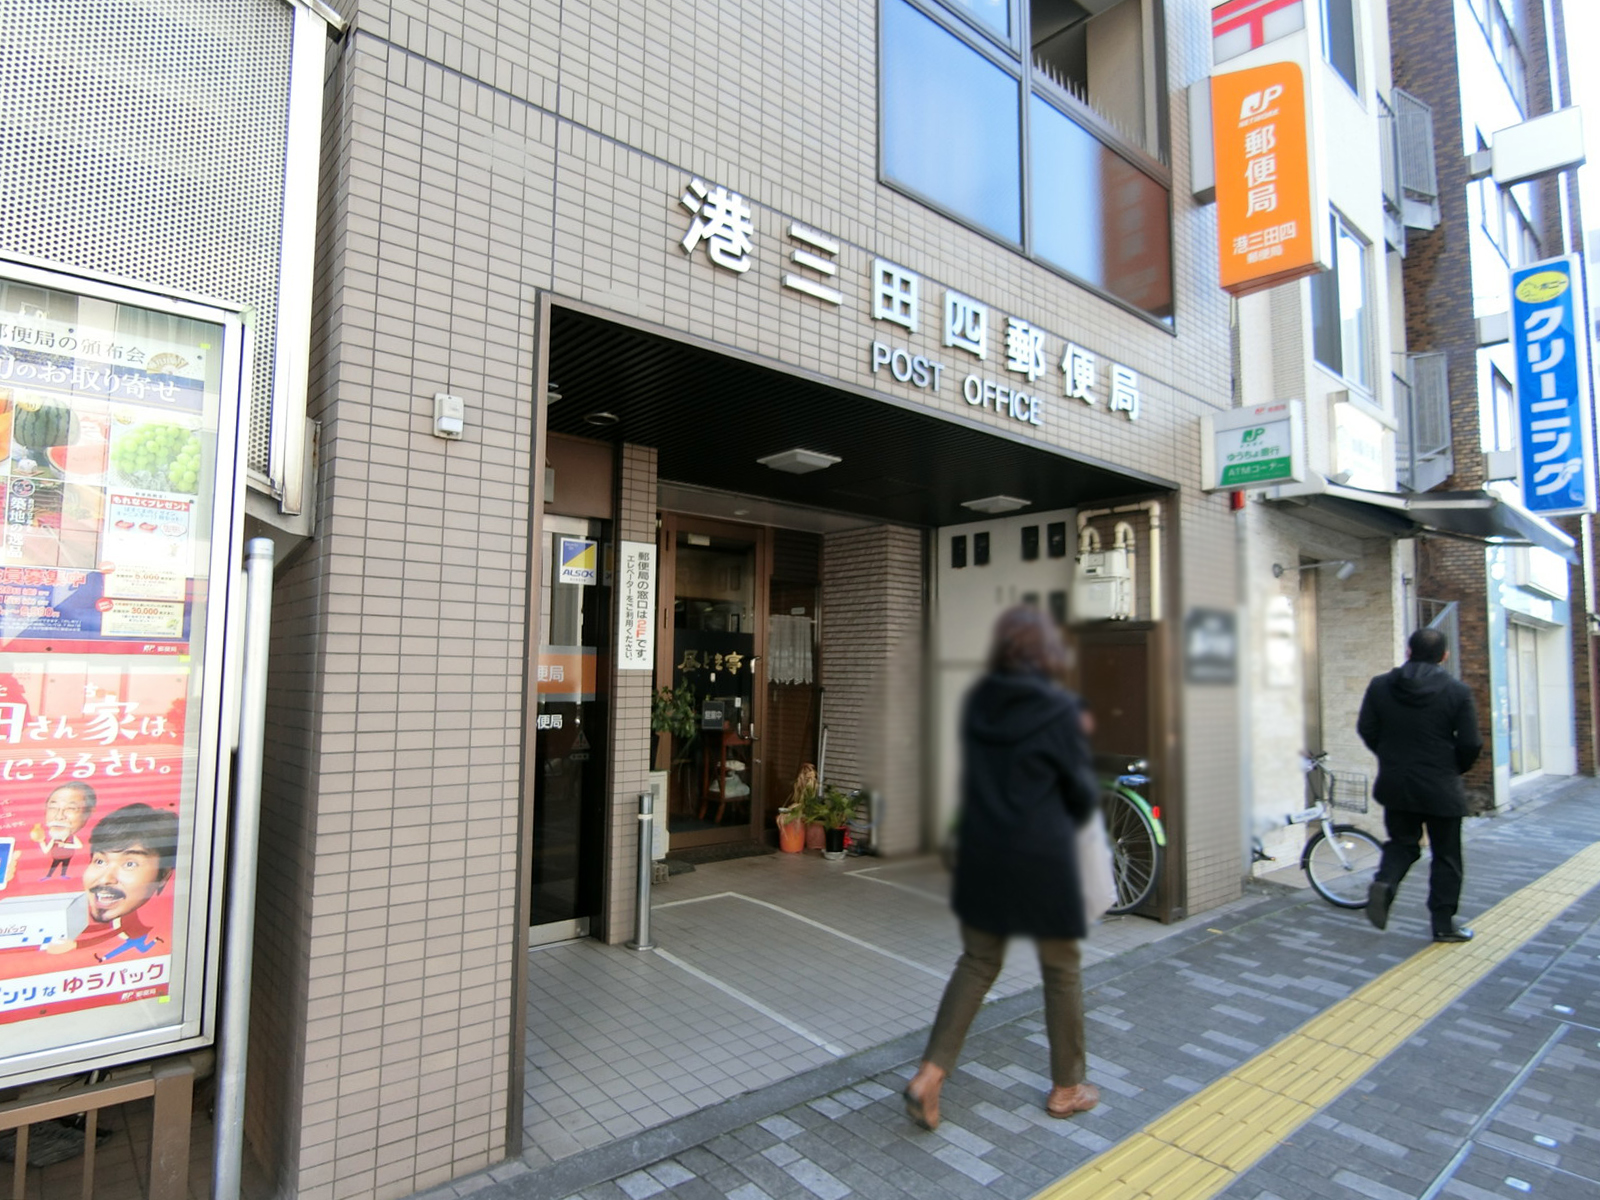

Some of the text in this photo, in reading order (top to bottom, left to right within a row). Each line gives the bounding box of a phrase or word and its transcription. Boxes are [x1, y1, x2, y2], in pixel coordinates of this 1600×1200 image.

[1244, 123, 1277, 218] 郵便局
[872, 340, 1044, 426] POST OFFICE
[1524, 305, 1582, 496] クリーニング
[562, 568, 594, 578] ALSOK
[3, 749, 171, 781] にうるさい。
